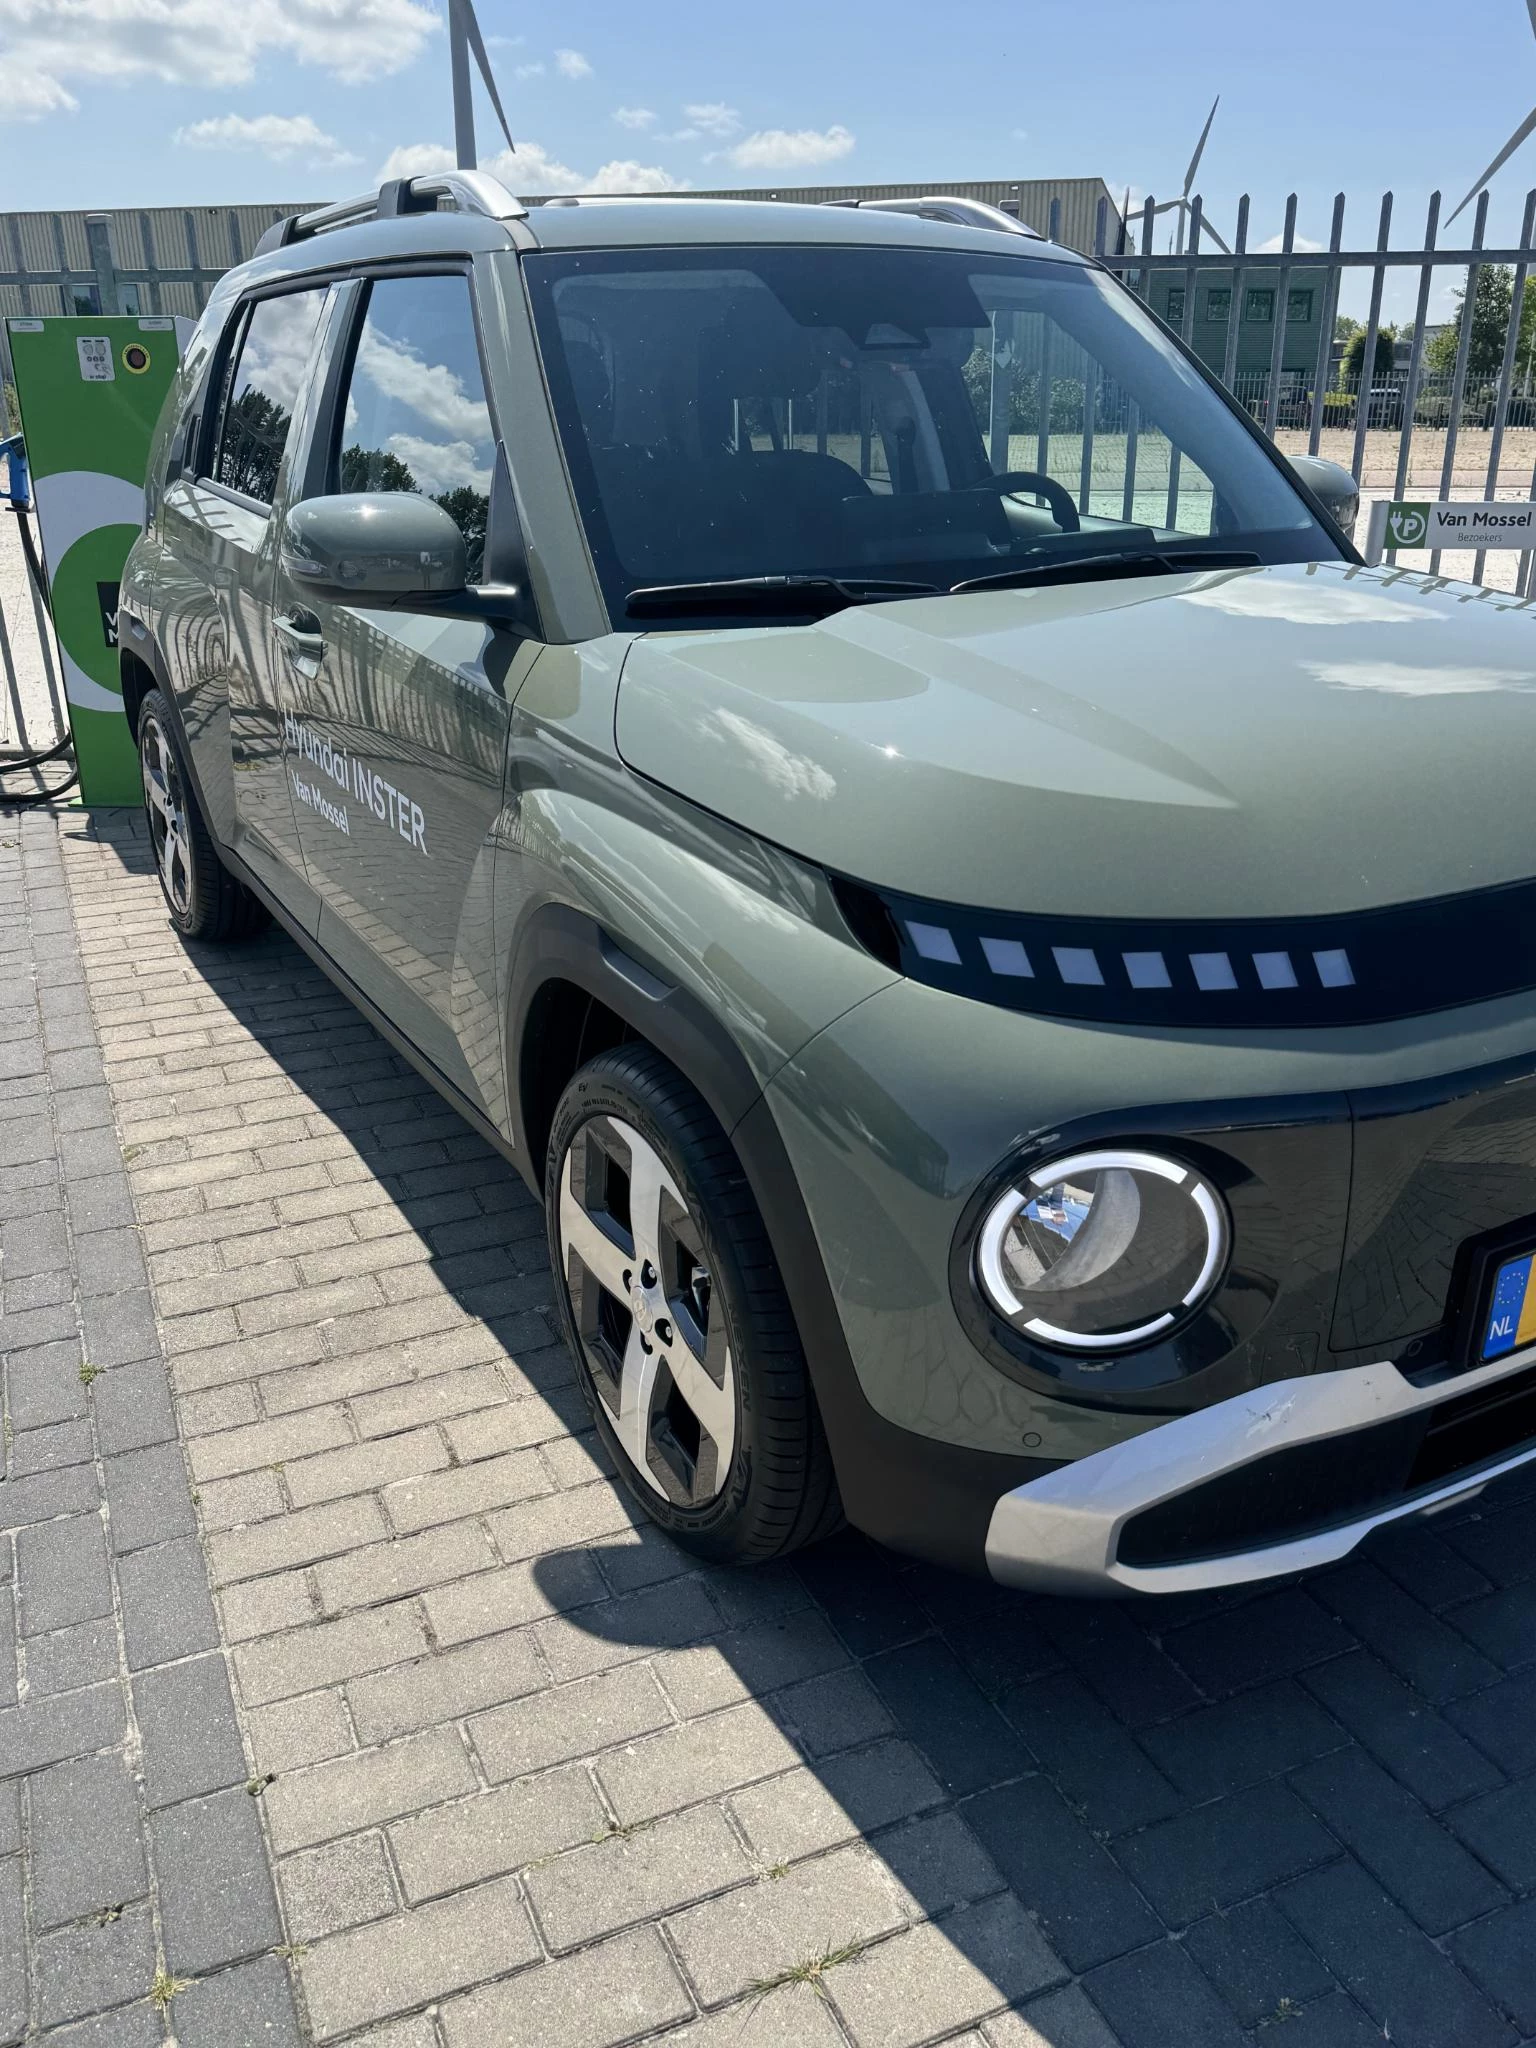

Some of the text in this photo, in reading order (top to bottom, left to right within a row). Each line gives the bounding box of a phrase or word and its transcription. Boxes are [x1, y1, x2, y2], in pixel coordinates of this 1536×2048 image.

[1436, 511, 1533, 527] Van Mossel
[1457, 532, 1503, 543] Bezoekers
[283, 703, 429, 856] Hyundai INSTER
[291, 769, 351, 836] Van Mossel
[1489, 1315, 1514, 1340] NL
